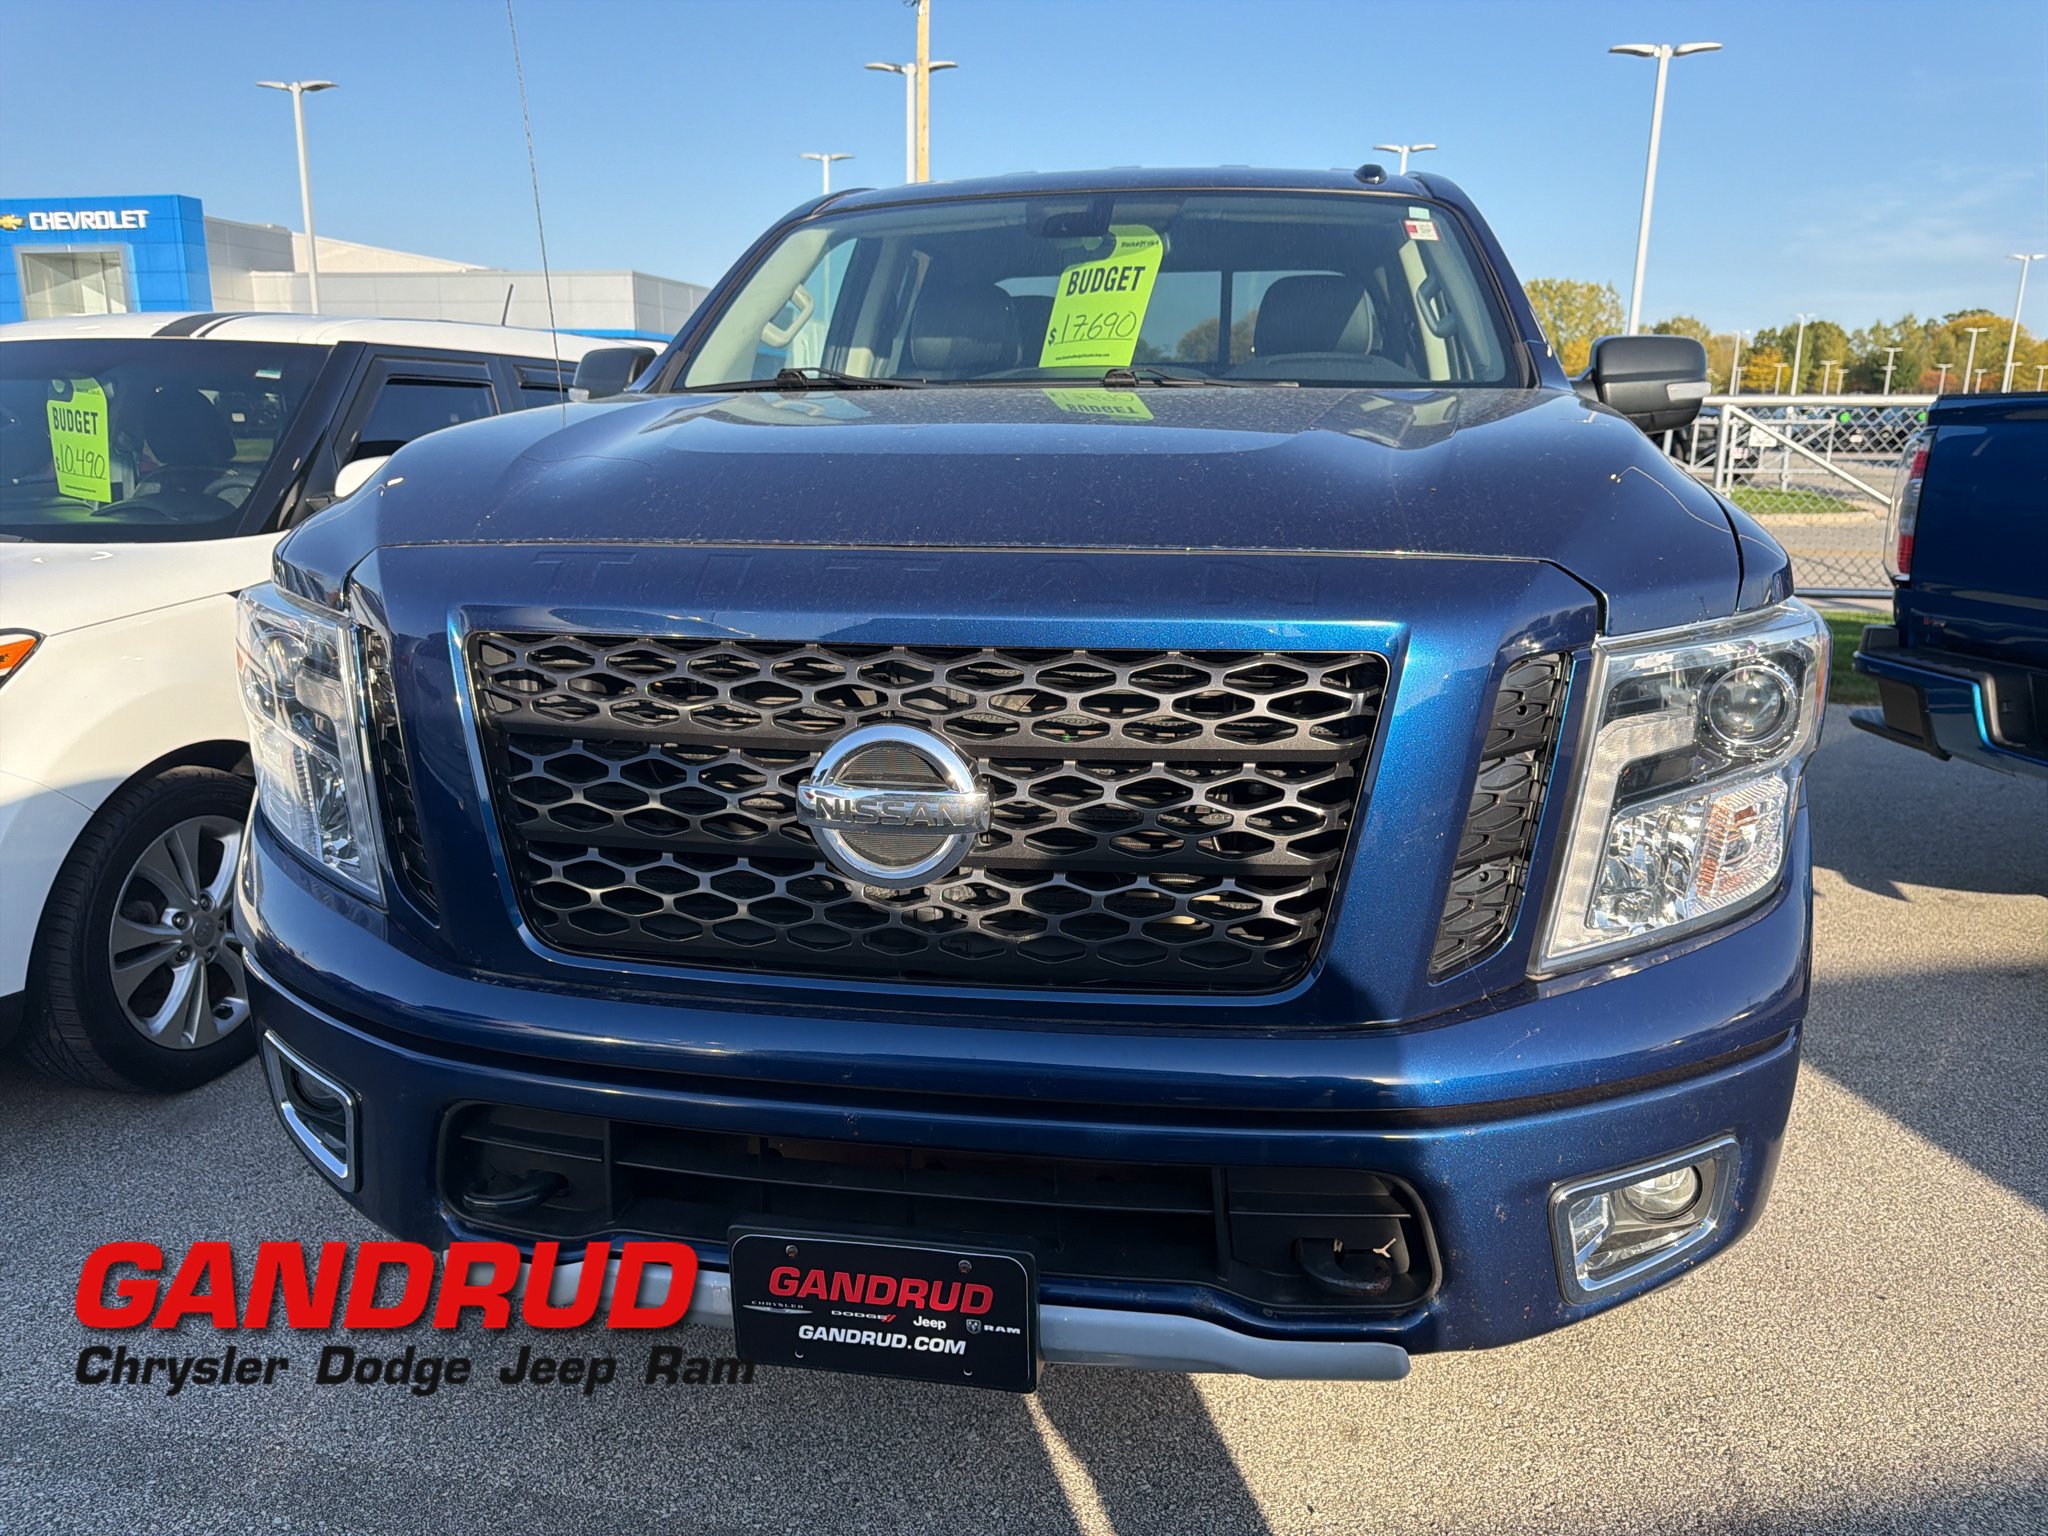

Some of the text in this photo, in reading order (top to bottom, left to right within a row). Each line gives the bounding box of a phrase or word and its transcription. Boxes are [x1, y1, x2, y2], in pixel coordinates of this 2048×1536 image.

[29, 210, 150, 231] CHEVROLET
[1067, 266, 1145, 296] BUDGET
[52, 406, 98, 435] BUDGET
[815, 797, 967, 827] NISSAN
[768, 1266, 994, 1314] GANDRUD
[751, 1300, 804, 1309] CHRYSLER
[831, 1310, 886, 1320] DODGE
[913, 1315, 947, 1331] Jeep
[983, 1324, 1021, 1335] RAM
[798, 1325, 966, 1355] GANDRUD.COM
